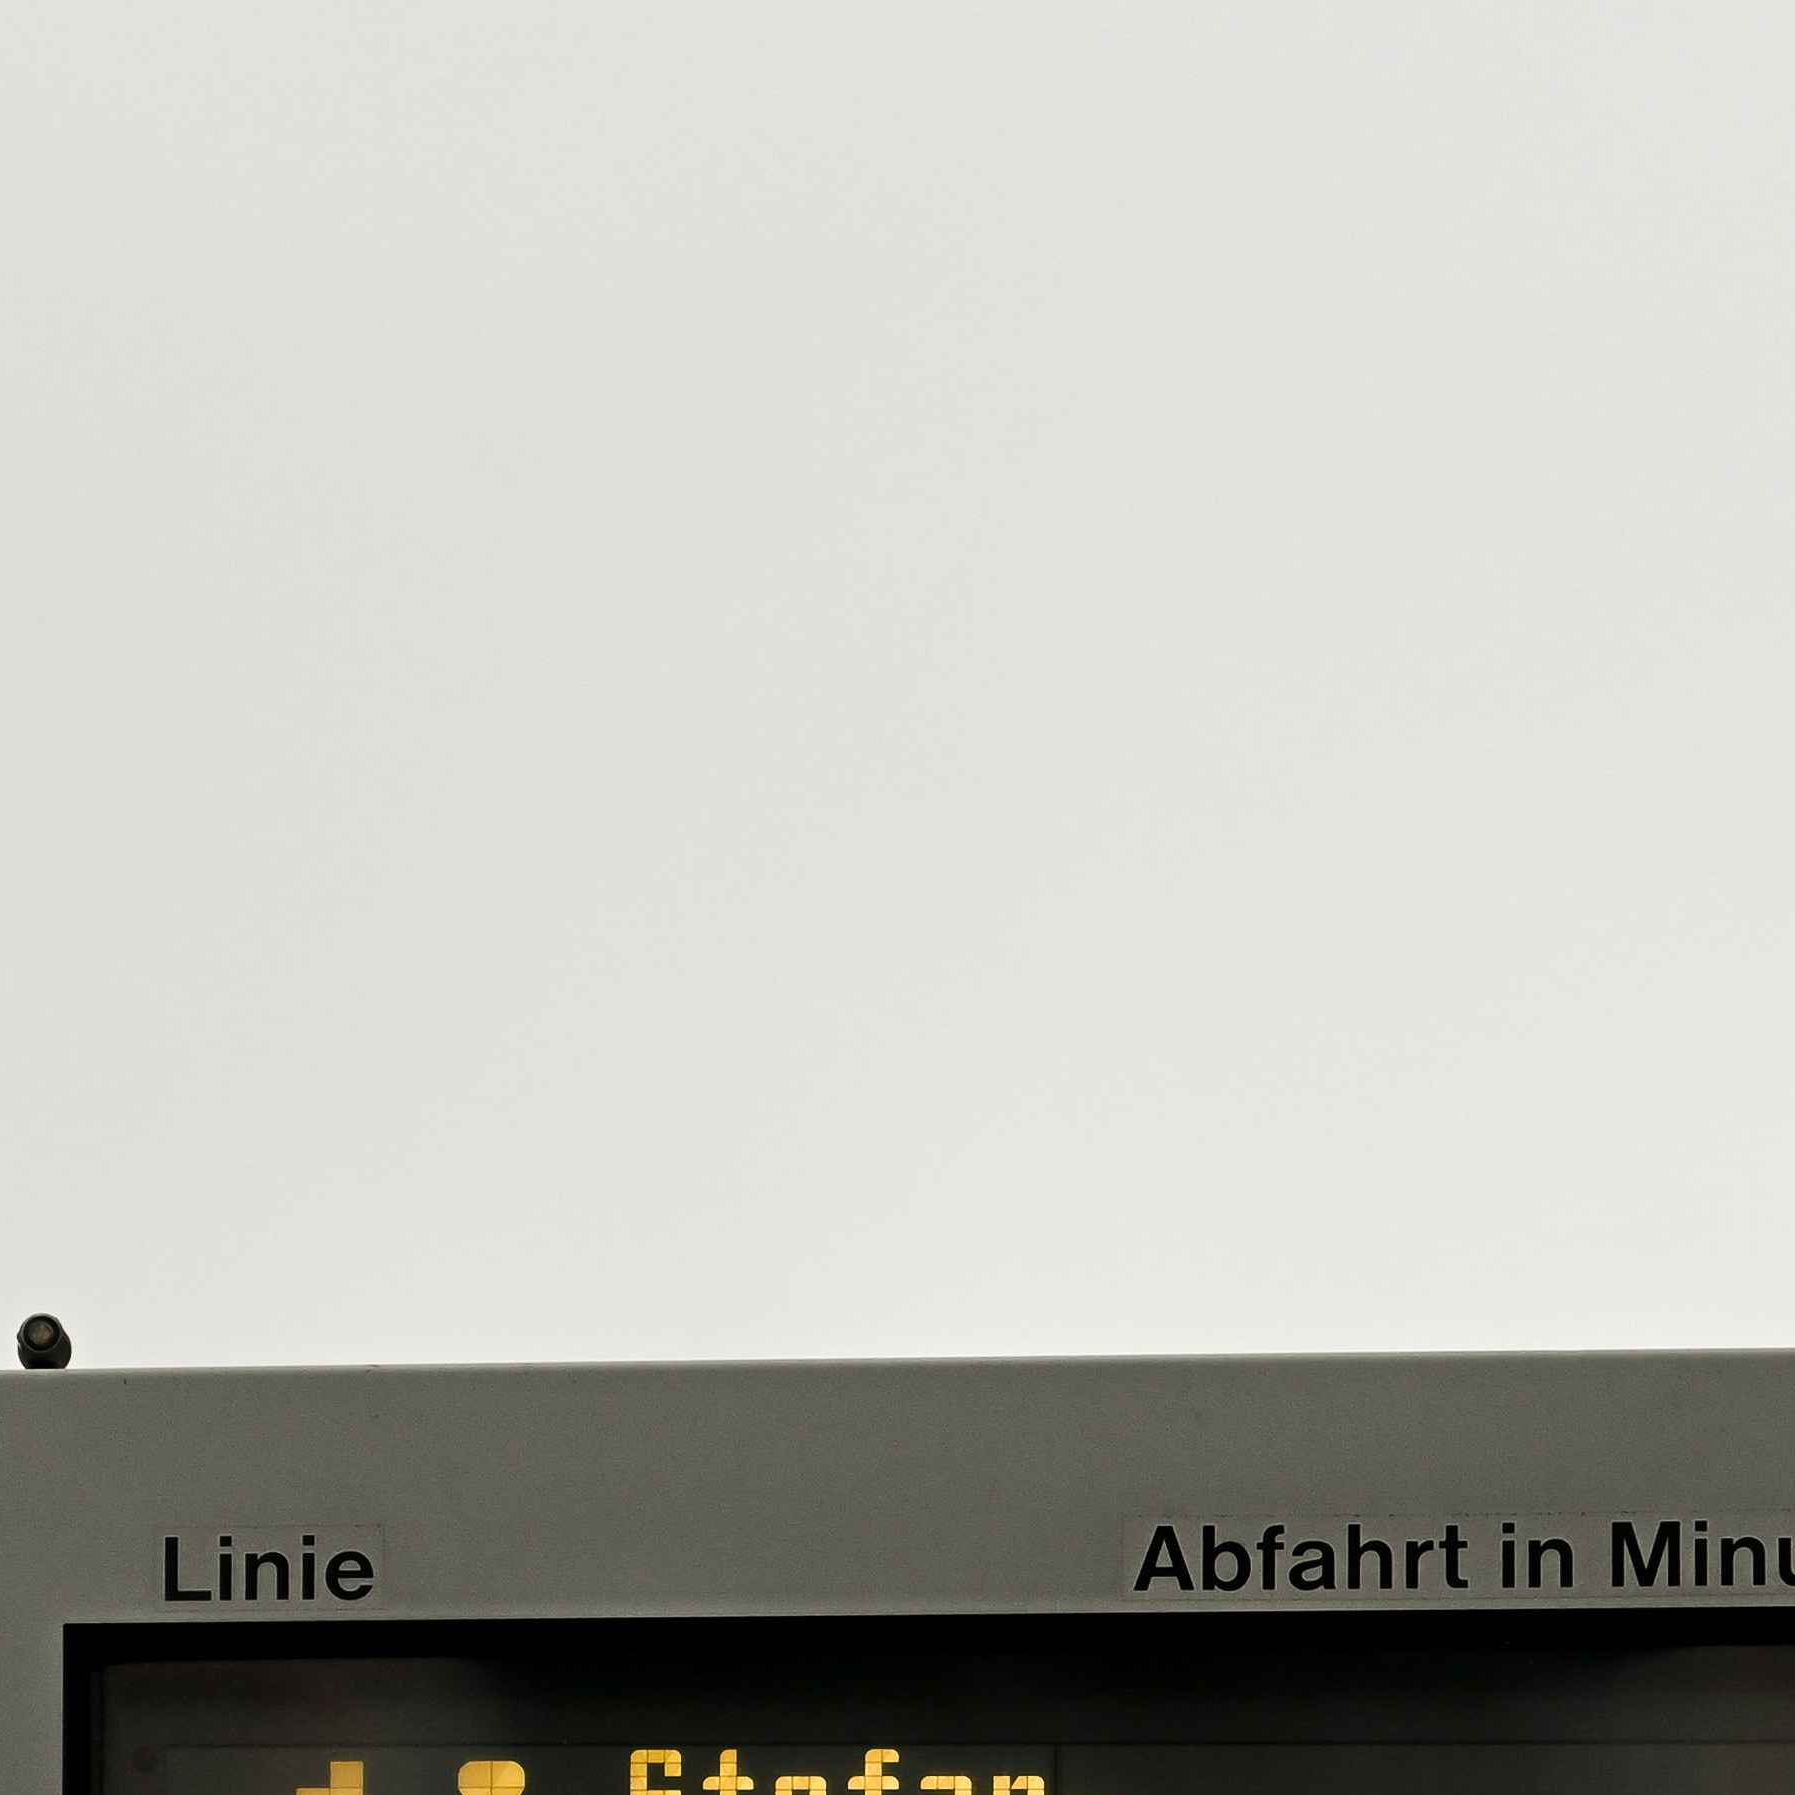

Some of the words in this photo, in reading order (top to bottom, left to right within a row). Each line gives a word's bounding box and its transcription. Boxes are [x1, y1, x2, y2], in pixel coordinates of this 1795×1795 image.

[165, 1535, 373, 1601] Linie
[1135, 1524, 1468, 1591] Abfahrt
[1503, 1523, 1572, 1588] in
